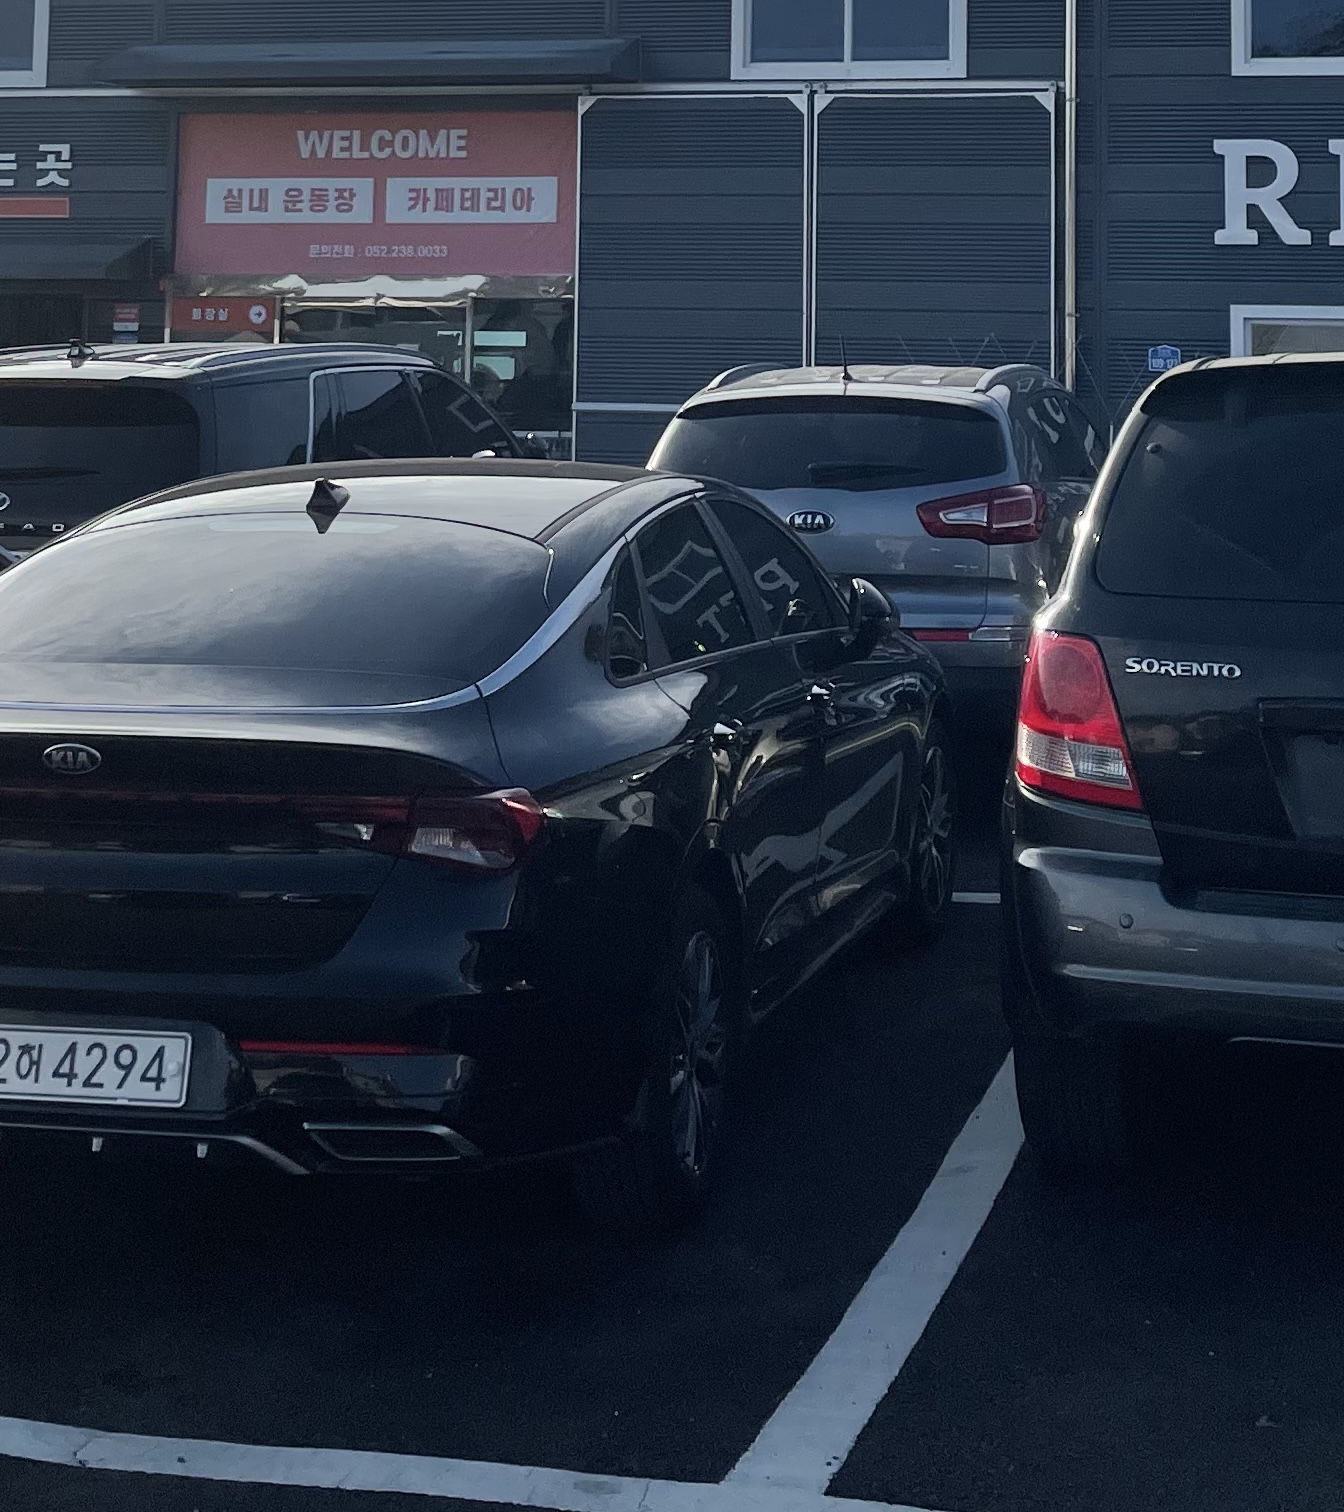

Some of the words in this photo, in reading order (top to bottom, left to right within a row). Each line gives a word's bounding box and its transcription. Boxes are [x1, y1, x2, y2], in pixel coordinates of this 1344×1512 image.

[296, 129, 468, 159] WELCOME
[222, 187, 269, 214] 실내
[283, 187, 357, 214] 운동장
[407, 186, 536, 214] 카페테리아
[794, 514, 825, 529] KIA
[1125, 657, 1242, 679] SORENTO
[51, 750, 93, 769] KIA
